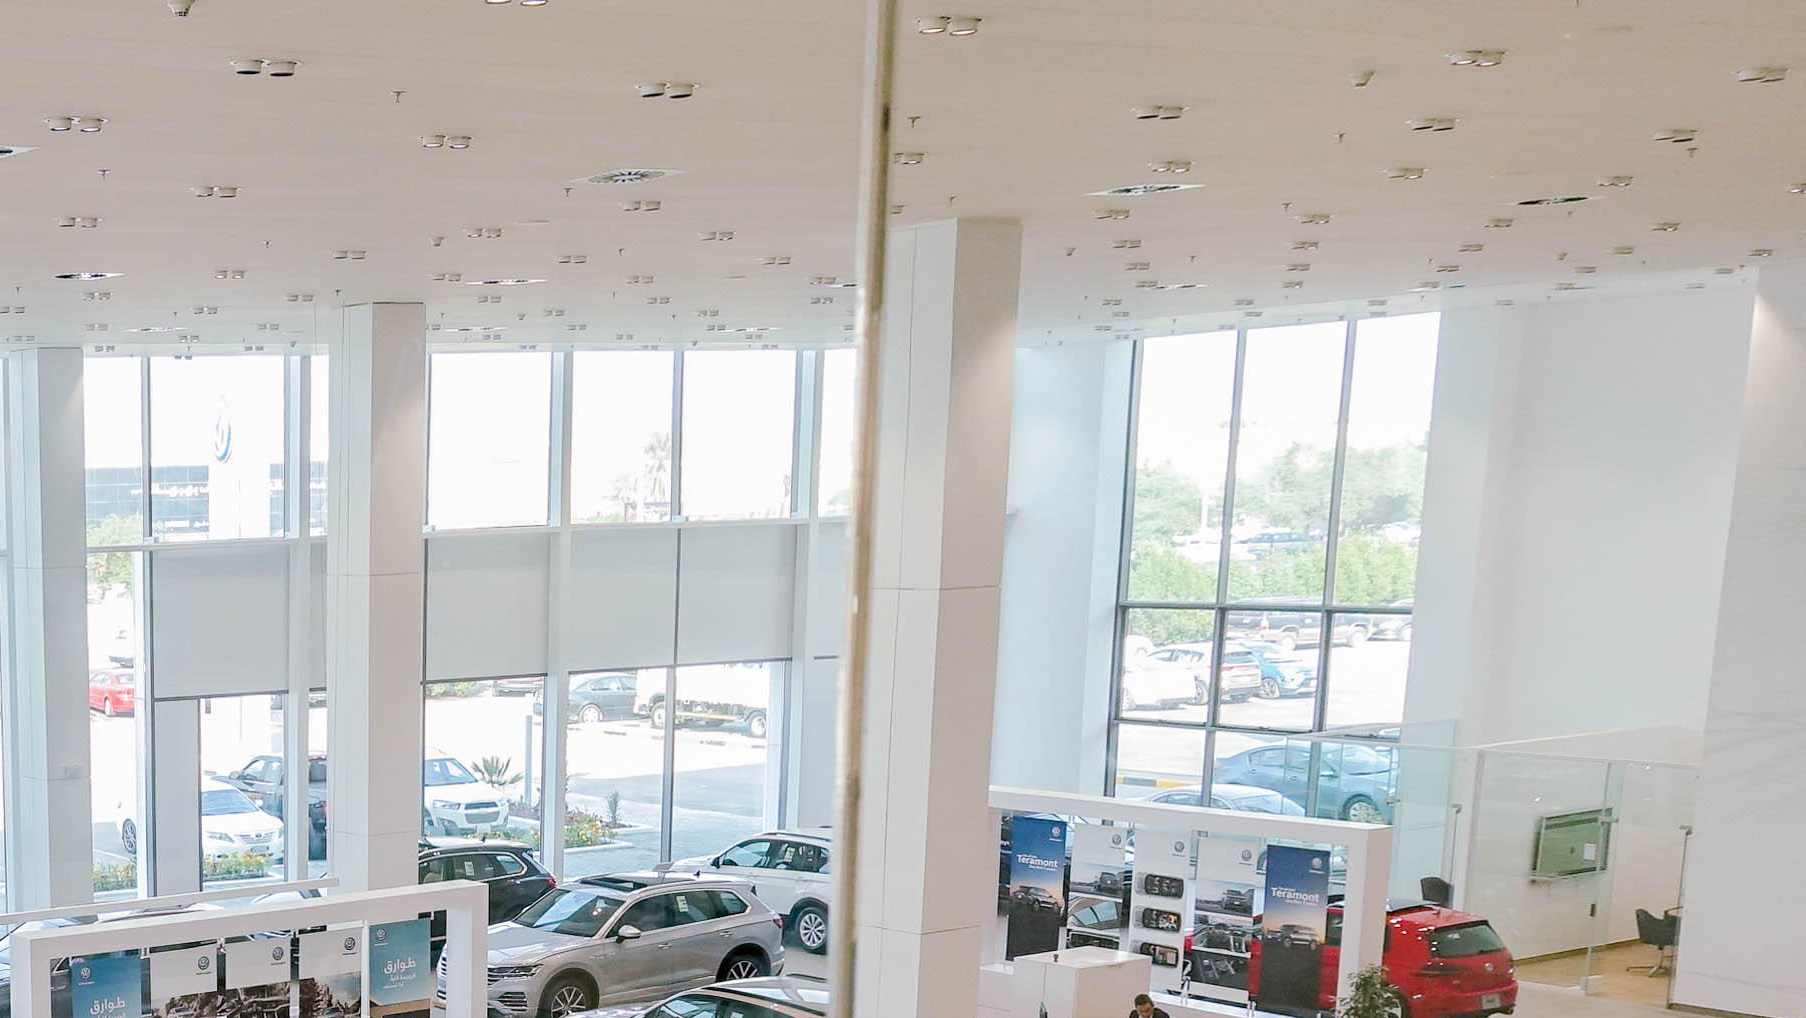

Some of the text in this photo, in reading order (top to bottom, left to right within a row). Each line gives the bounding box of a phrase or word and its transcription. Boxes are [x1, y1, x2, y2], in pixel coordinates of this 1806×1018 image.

[1016, 854, 1059, 868] Teramont
[1270, 887, 1320, 903] Teramont
[383, 957, 416, 974] طوارق
[89, 996, 125, 1015] طوارق
